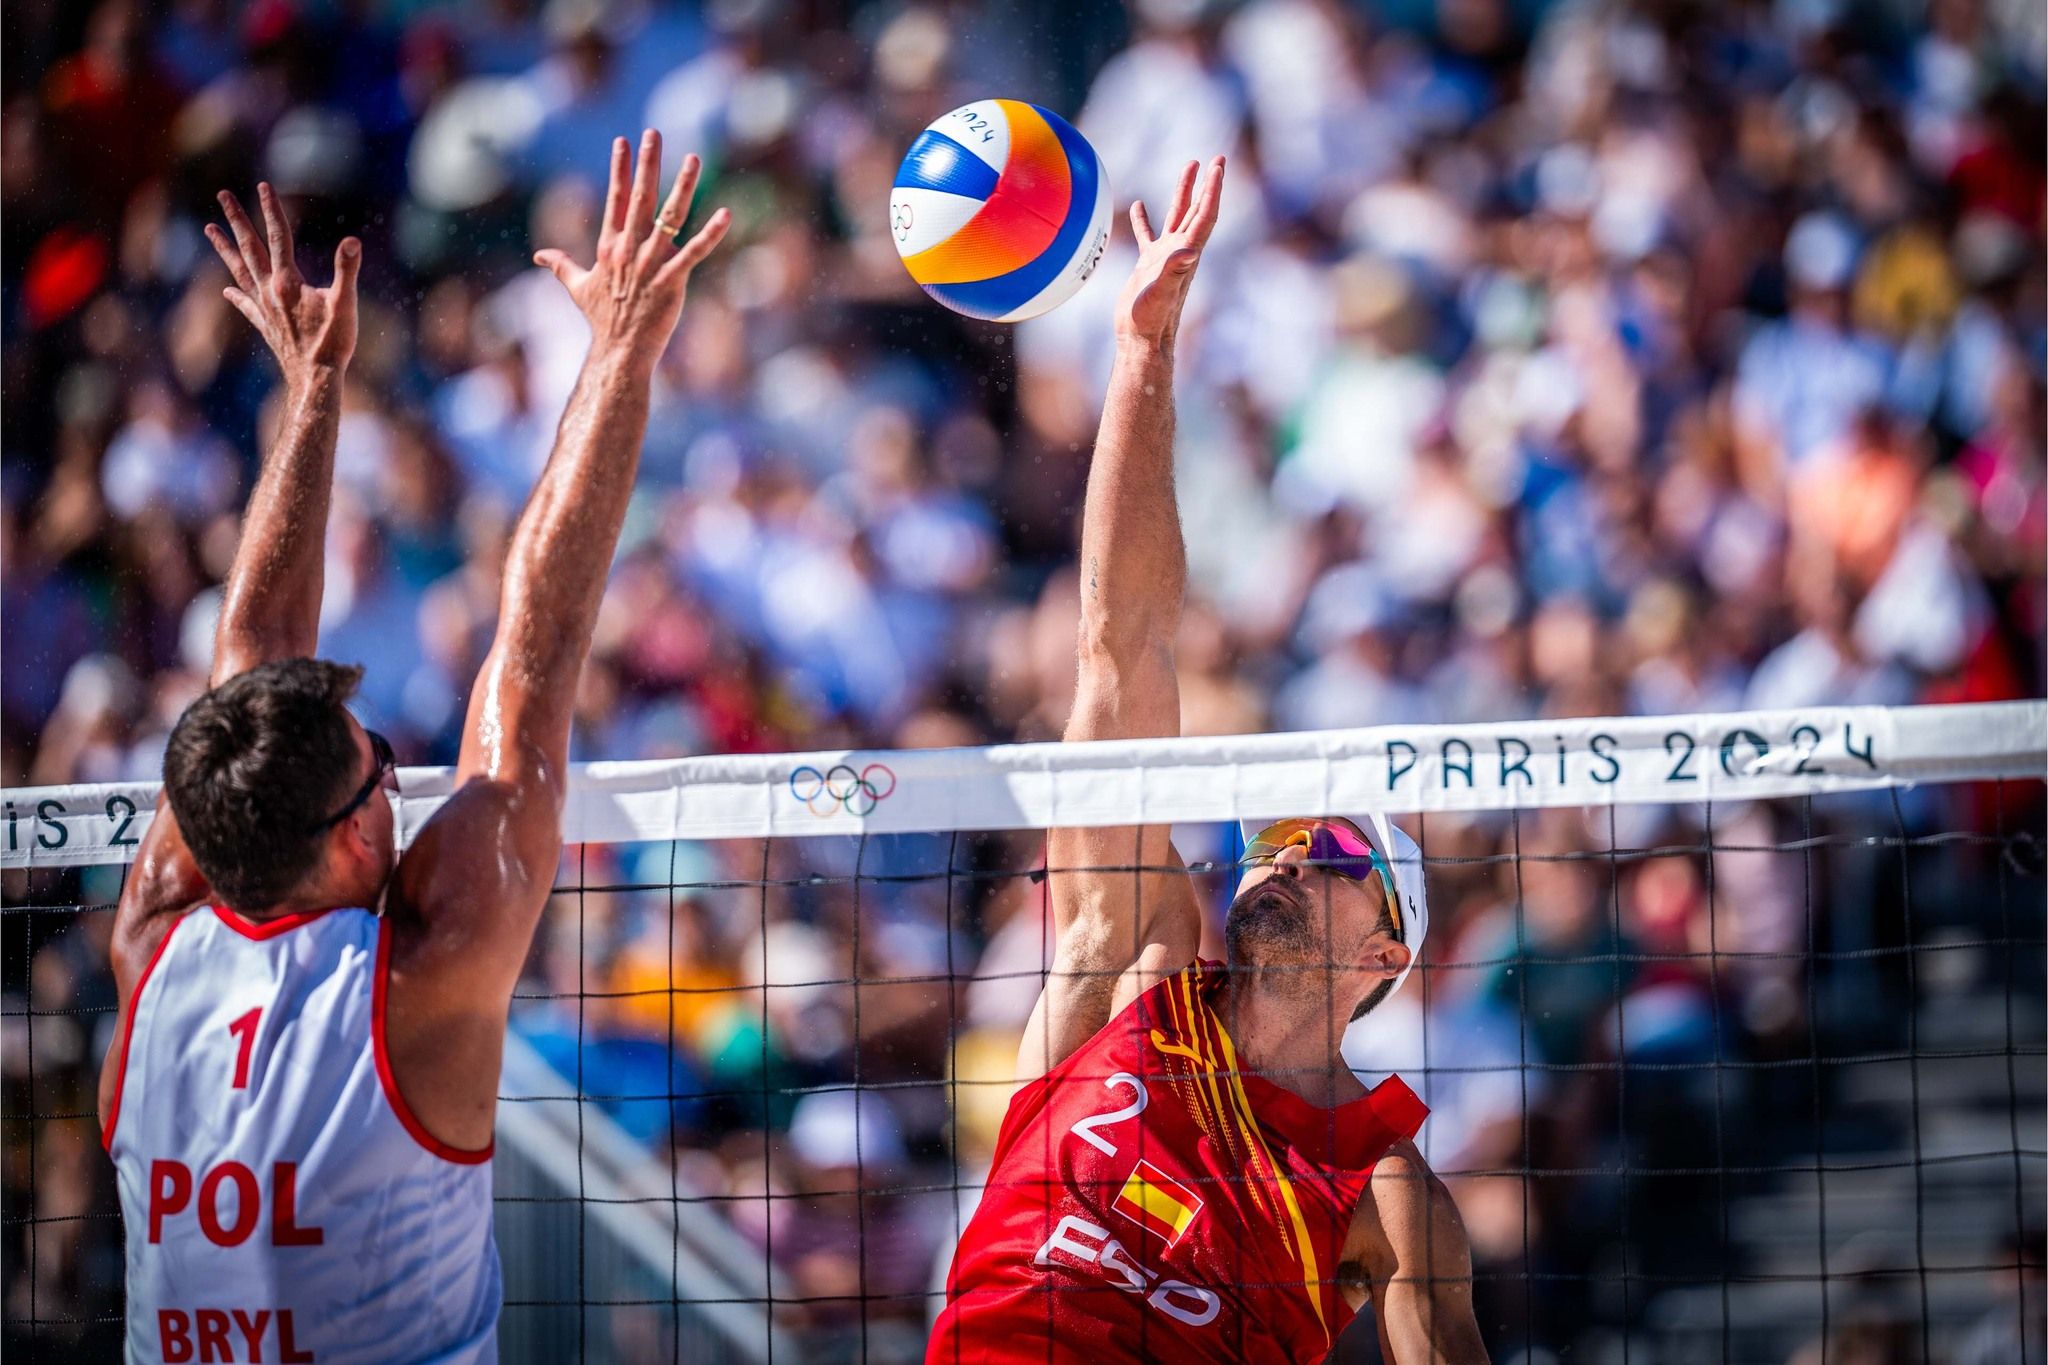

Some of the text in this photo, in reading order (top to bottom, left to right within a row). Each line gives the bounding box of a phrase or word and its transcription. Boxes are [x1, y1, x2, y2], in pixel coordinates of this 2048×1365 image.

[952, 108, 995, 143] 024
[1664, 723, 1877, 782] 2024
[105, 795, 140, 847] 2
[229, 1006, 263, 1089] 1
[1070, 1072, 1149, 1158] 2
[148, 1159, 324, 1248] POL
[157, 1308, 315, 1364] BRYL
